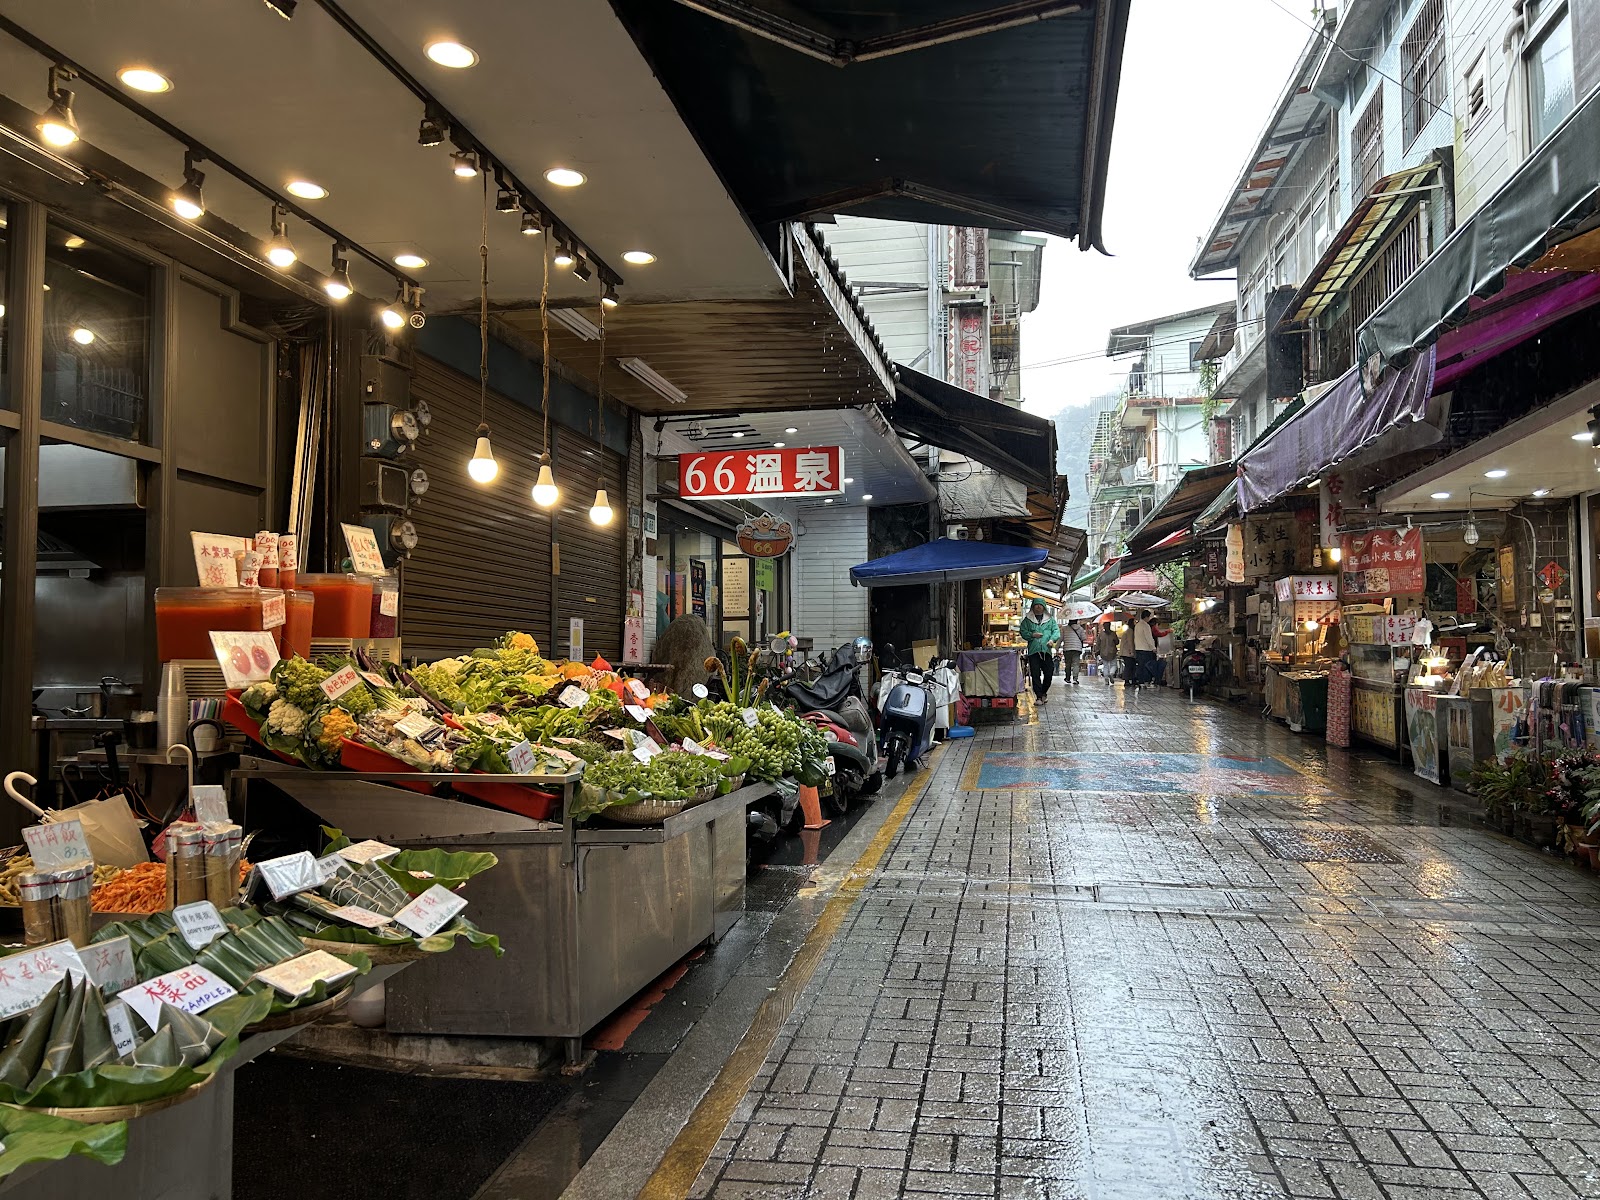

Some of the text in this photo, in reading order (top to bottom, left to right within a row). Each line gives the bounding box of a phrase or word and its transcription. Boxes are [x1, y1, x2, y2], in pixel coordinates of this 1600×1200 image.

[753, 542, 773, 554] 66
[202, 923, 221, 932] TOUCH
[116, 1038, 132, 1050] UCH
